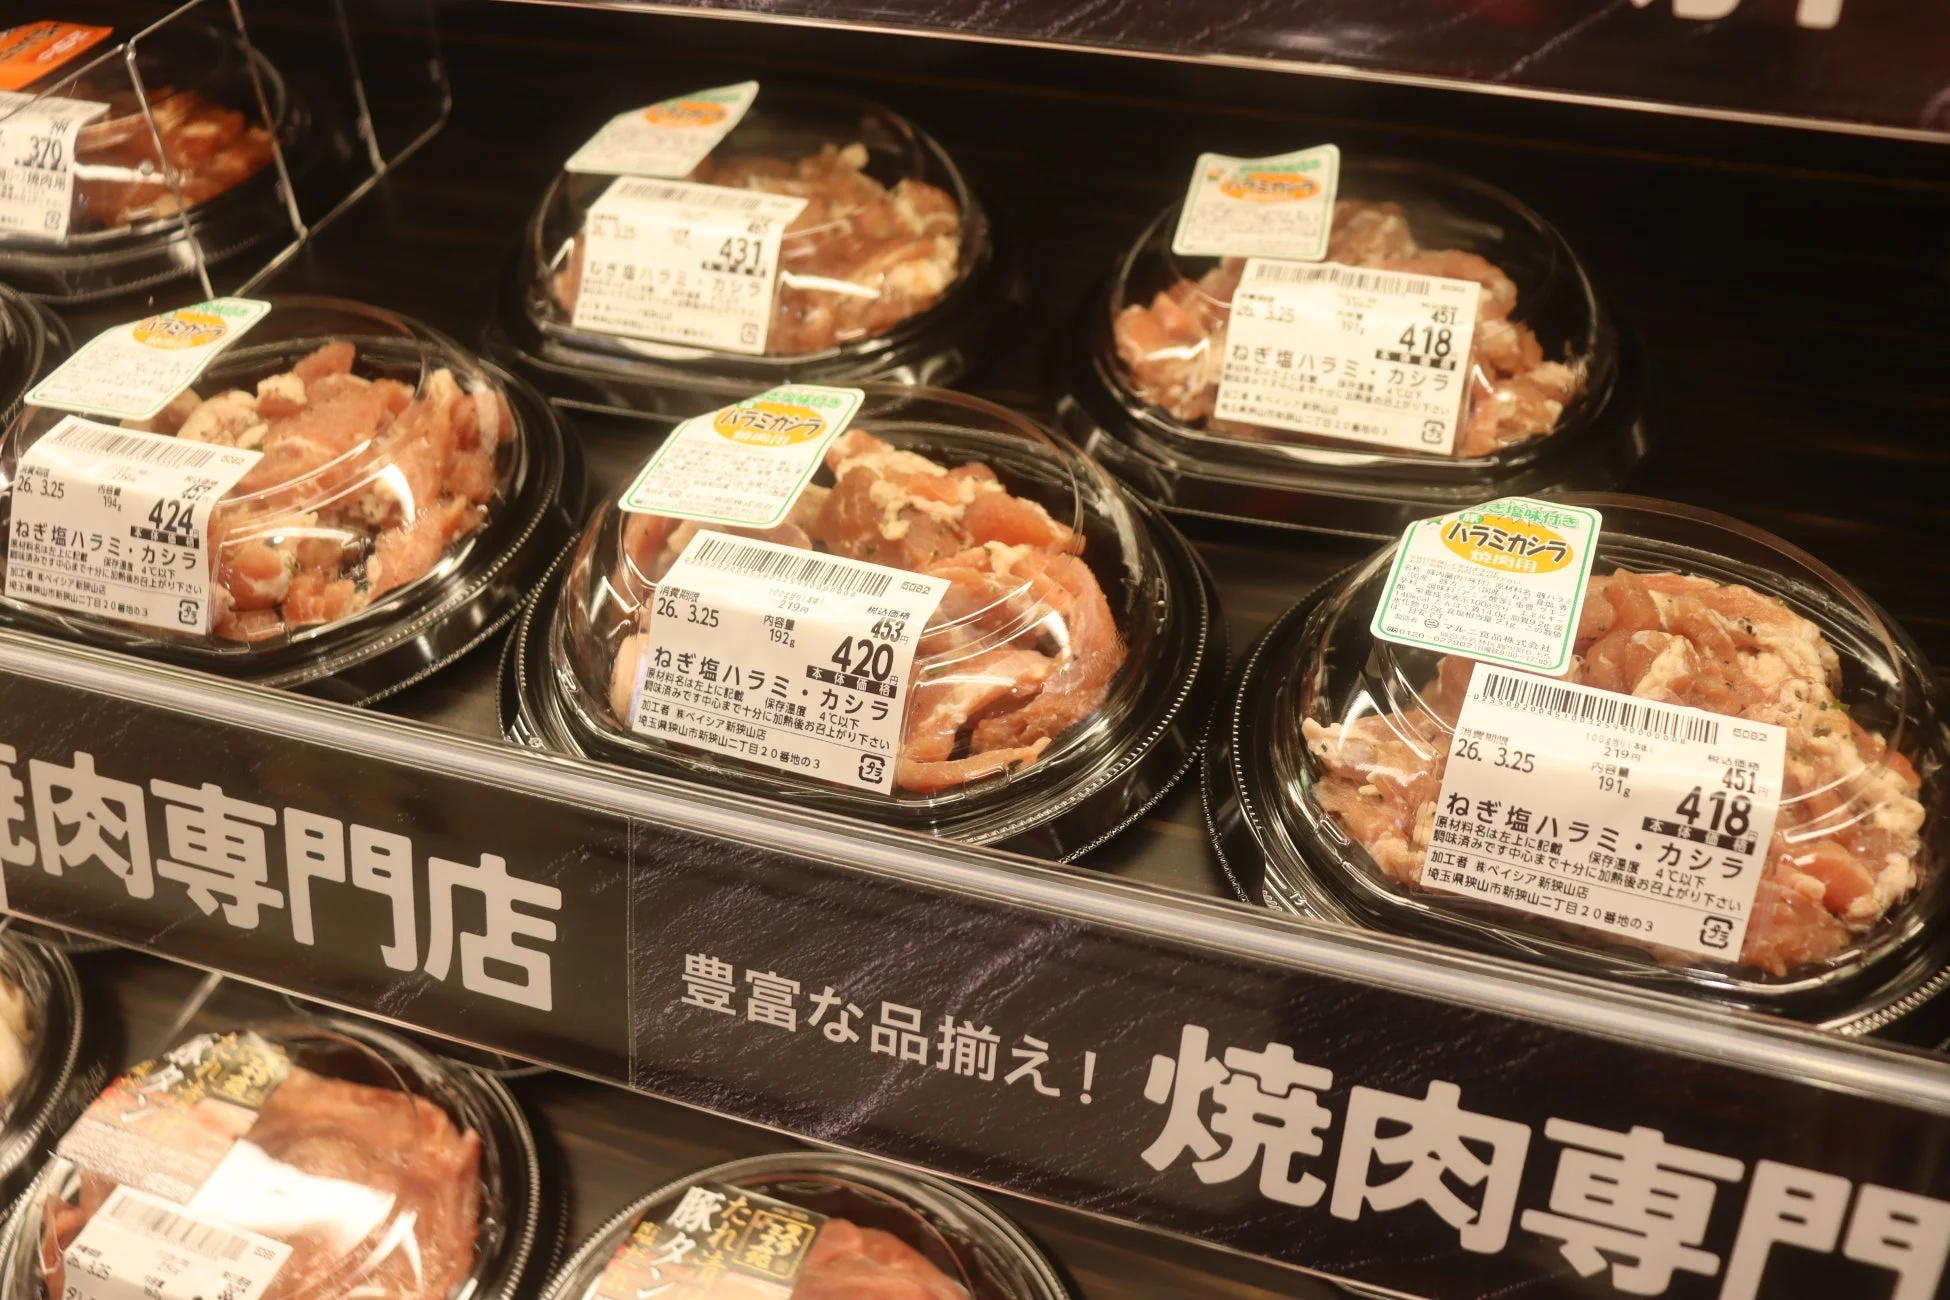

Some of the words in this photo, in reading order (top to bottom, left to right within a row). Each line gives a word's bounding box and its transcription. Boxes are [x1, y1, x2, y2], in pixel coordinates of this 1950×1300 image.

[1231, 342, 1450, 393] ねぎ塩ハラミ・カシラ
[720, 409, 823, 437] ハラミカシラ
[17, 475, 33, 494] 26.
[40, 478, 65, 499] 3.25
[15, 518, 197, 570] ねぎ塩ハラミ・カシラ
[1449, 522, 1568, 563] ハラミカシラ
[659, 584, 701, 602] 消費期限
[657, 597, 679, 619] 26.
[687, 604, 719, 628] 3.25
[764, 614, 796, 632] 内容量
[769, 627, 796, 649] 192g
[646, 666, 745, 702] 原材料名は左上に記載
[764, 697, 807, 718] 保存温度
[653, 645, 890, 721] ねぎ塩ハラミ・カシラ
[811, 666, 892, 697] 本体価格
[641, 699, 671, 717] 加工者
[643, 679, 891, 750] 調味済みです中心まで十分に加熱後お召上がり下さい
[1455, 738, 1483, 762] 26.
[1494, 747, 1535, 774] 3.25
[1591, 761, 1630, 778] 内容量
[1597, 774, 1631, 798] 191g
[1435, 815, 1564, 857] 原材料名は左上に記載
[1588, 850, 1641, 876] 保存温度
[1446, 791, 1744, 879] ねぎ塩ハラミ・カシラ
[1430, 850, 1469, 869] 加工者
[1432, 828, 1742, 912] 調味済みです中心まで十分に加熱後お召上がり下さい
[1427, 866, 1655, 933] 埼玉県狭山市新狭山二丁目20番地の3
[680, 952, 1098, 1105] 豊富な品揃え!
